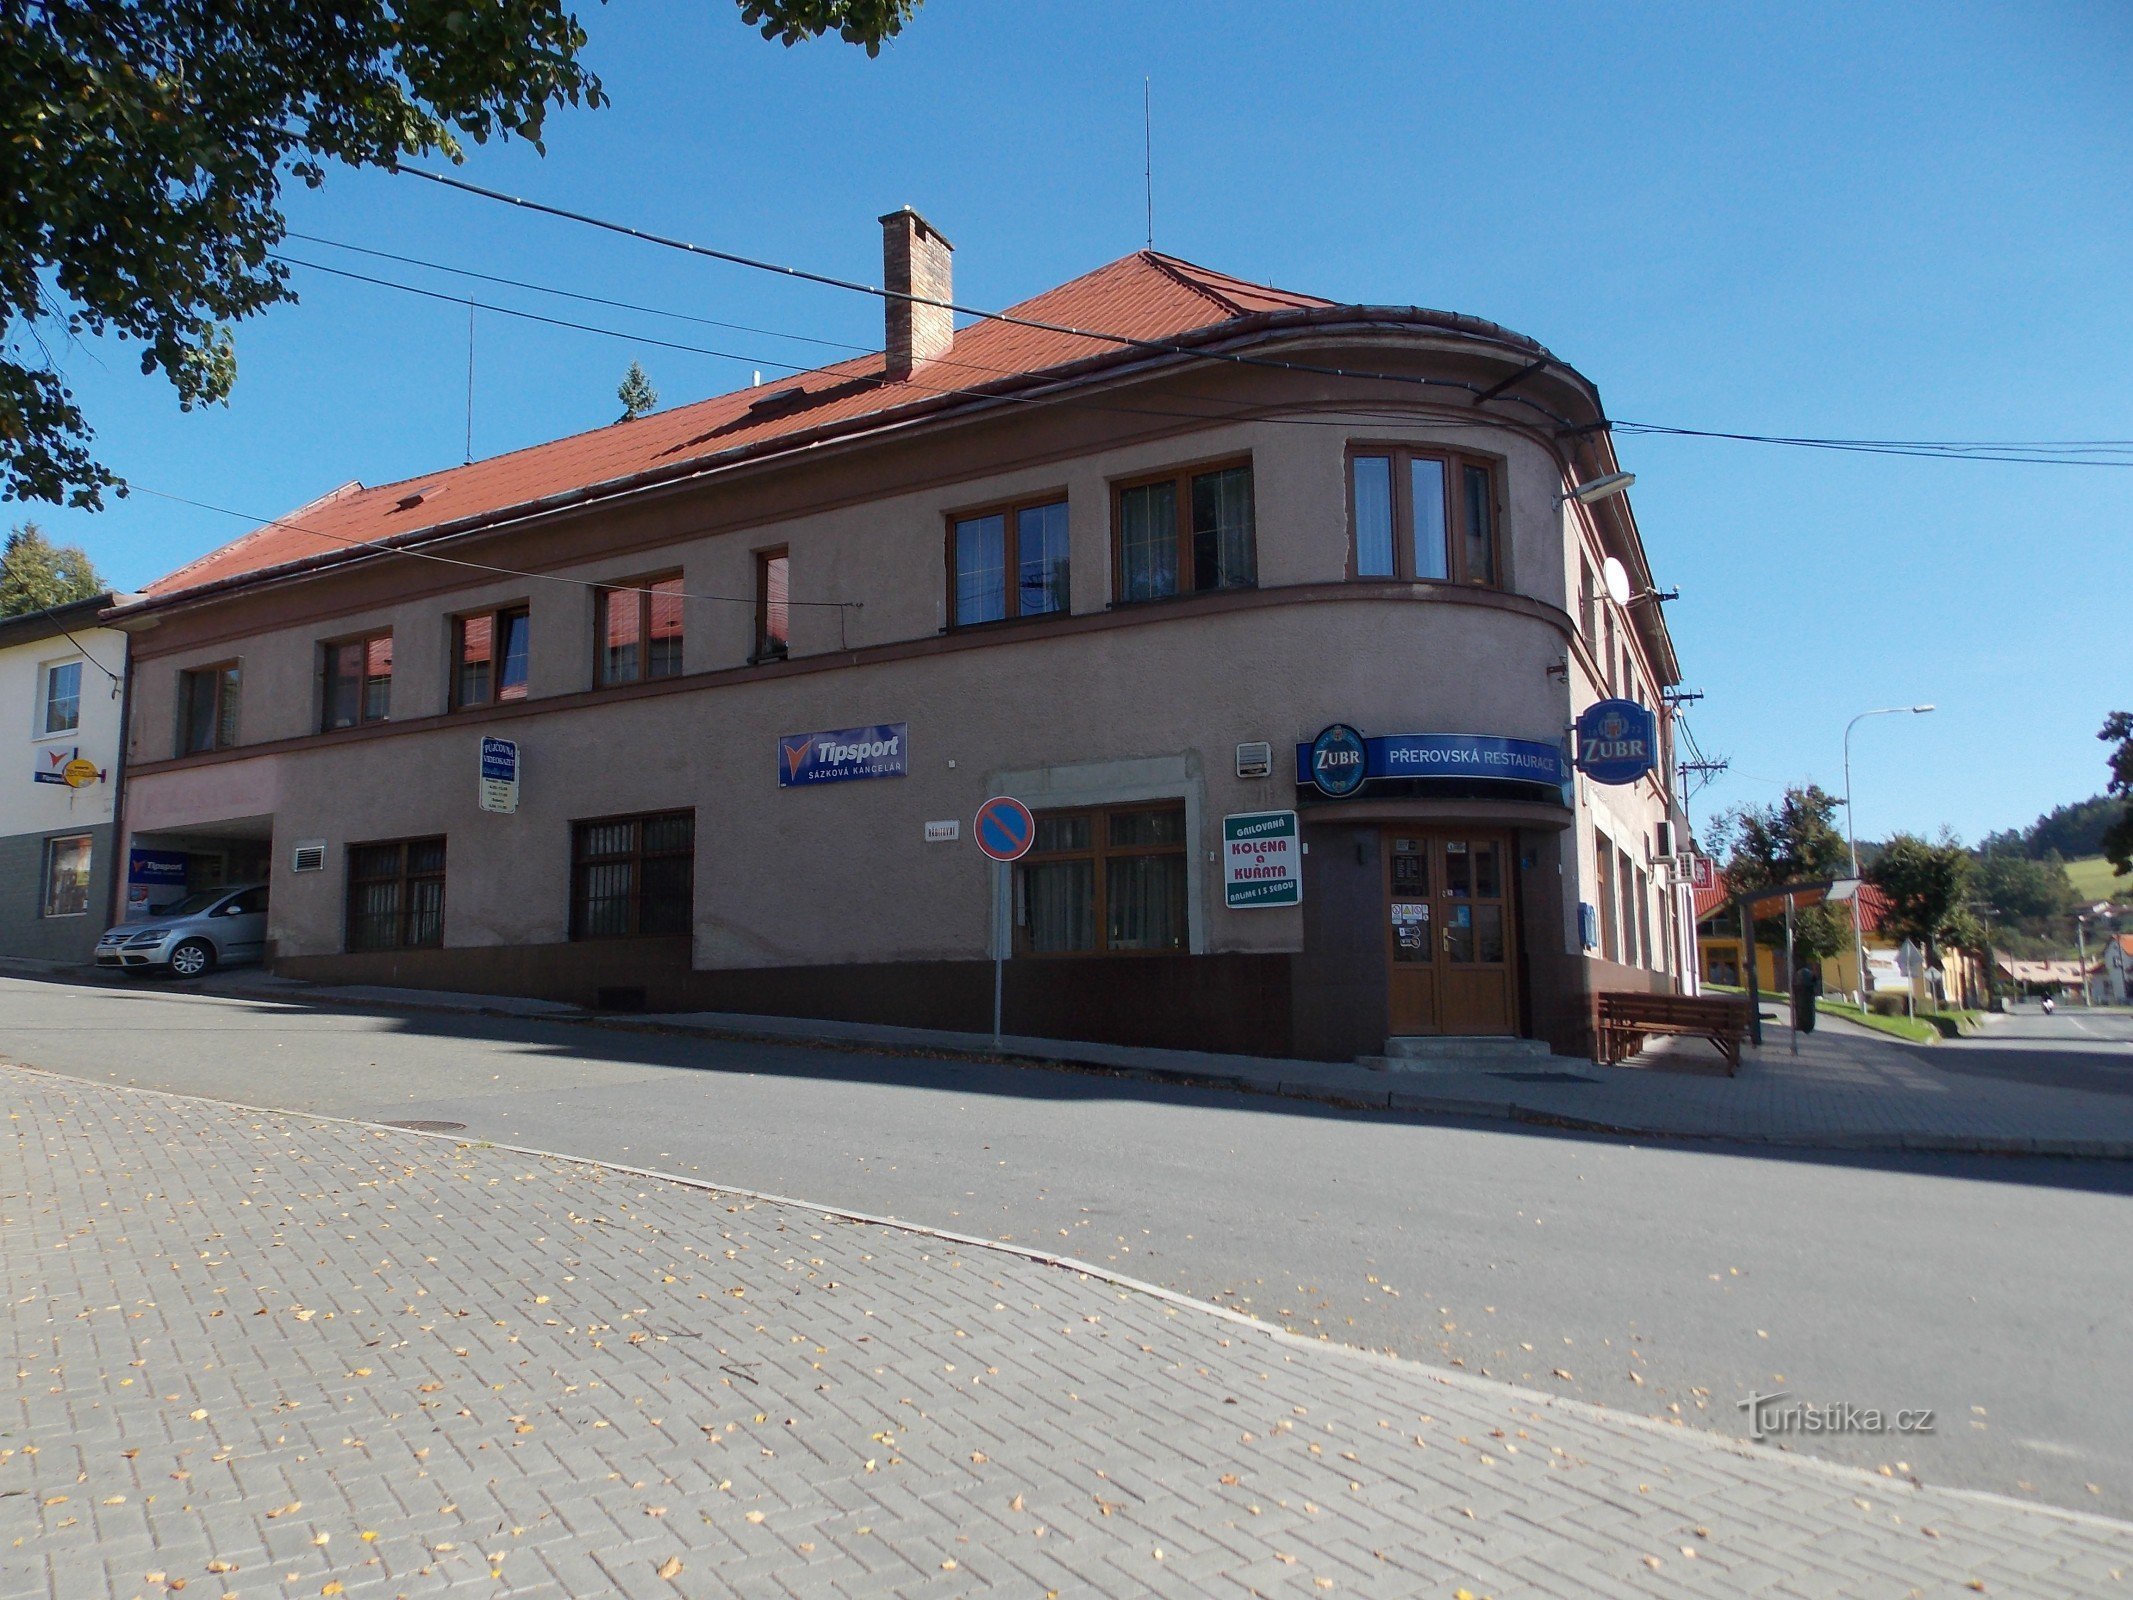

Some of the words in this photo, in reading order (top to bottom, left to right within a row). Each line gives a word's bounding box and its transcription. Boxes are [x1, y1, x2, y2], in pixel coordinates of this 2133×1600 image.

[818, 735, 899, 766] Tipsport
[1316, 749, 1360, 770] ZUBR
[1389, 748, 1480, 764] PŘEROVSKÁ
[1483, 751, 1555, 771] RESTAURACE
[1583, 738, 1646, 763] ZUBR
[808, 766, 849, 780] SÁZKOVÁ
[852, 762, 901, 775] KANCELÁŘ
[1236, 817, 1285, 837] GRILOVANÁ
[1231, 840, 1287, 855] KOLENA
[147, 861, 183, 871] Tipsport
[1234, 864, 1287, 880] KUŘATA
[1269, 881, 1294, 893] SEBOU
